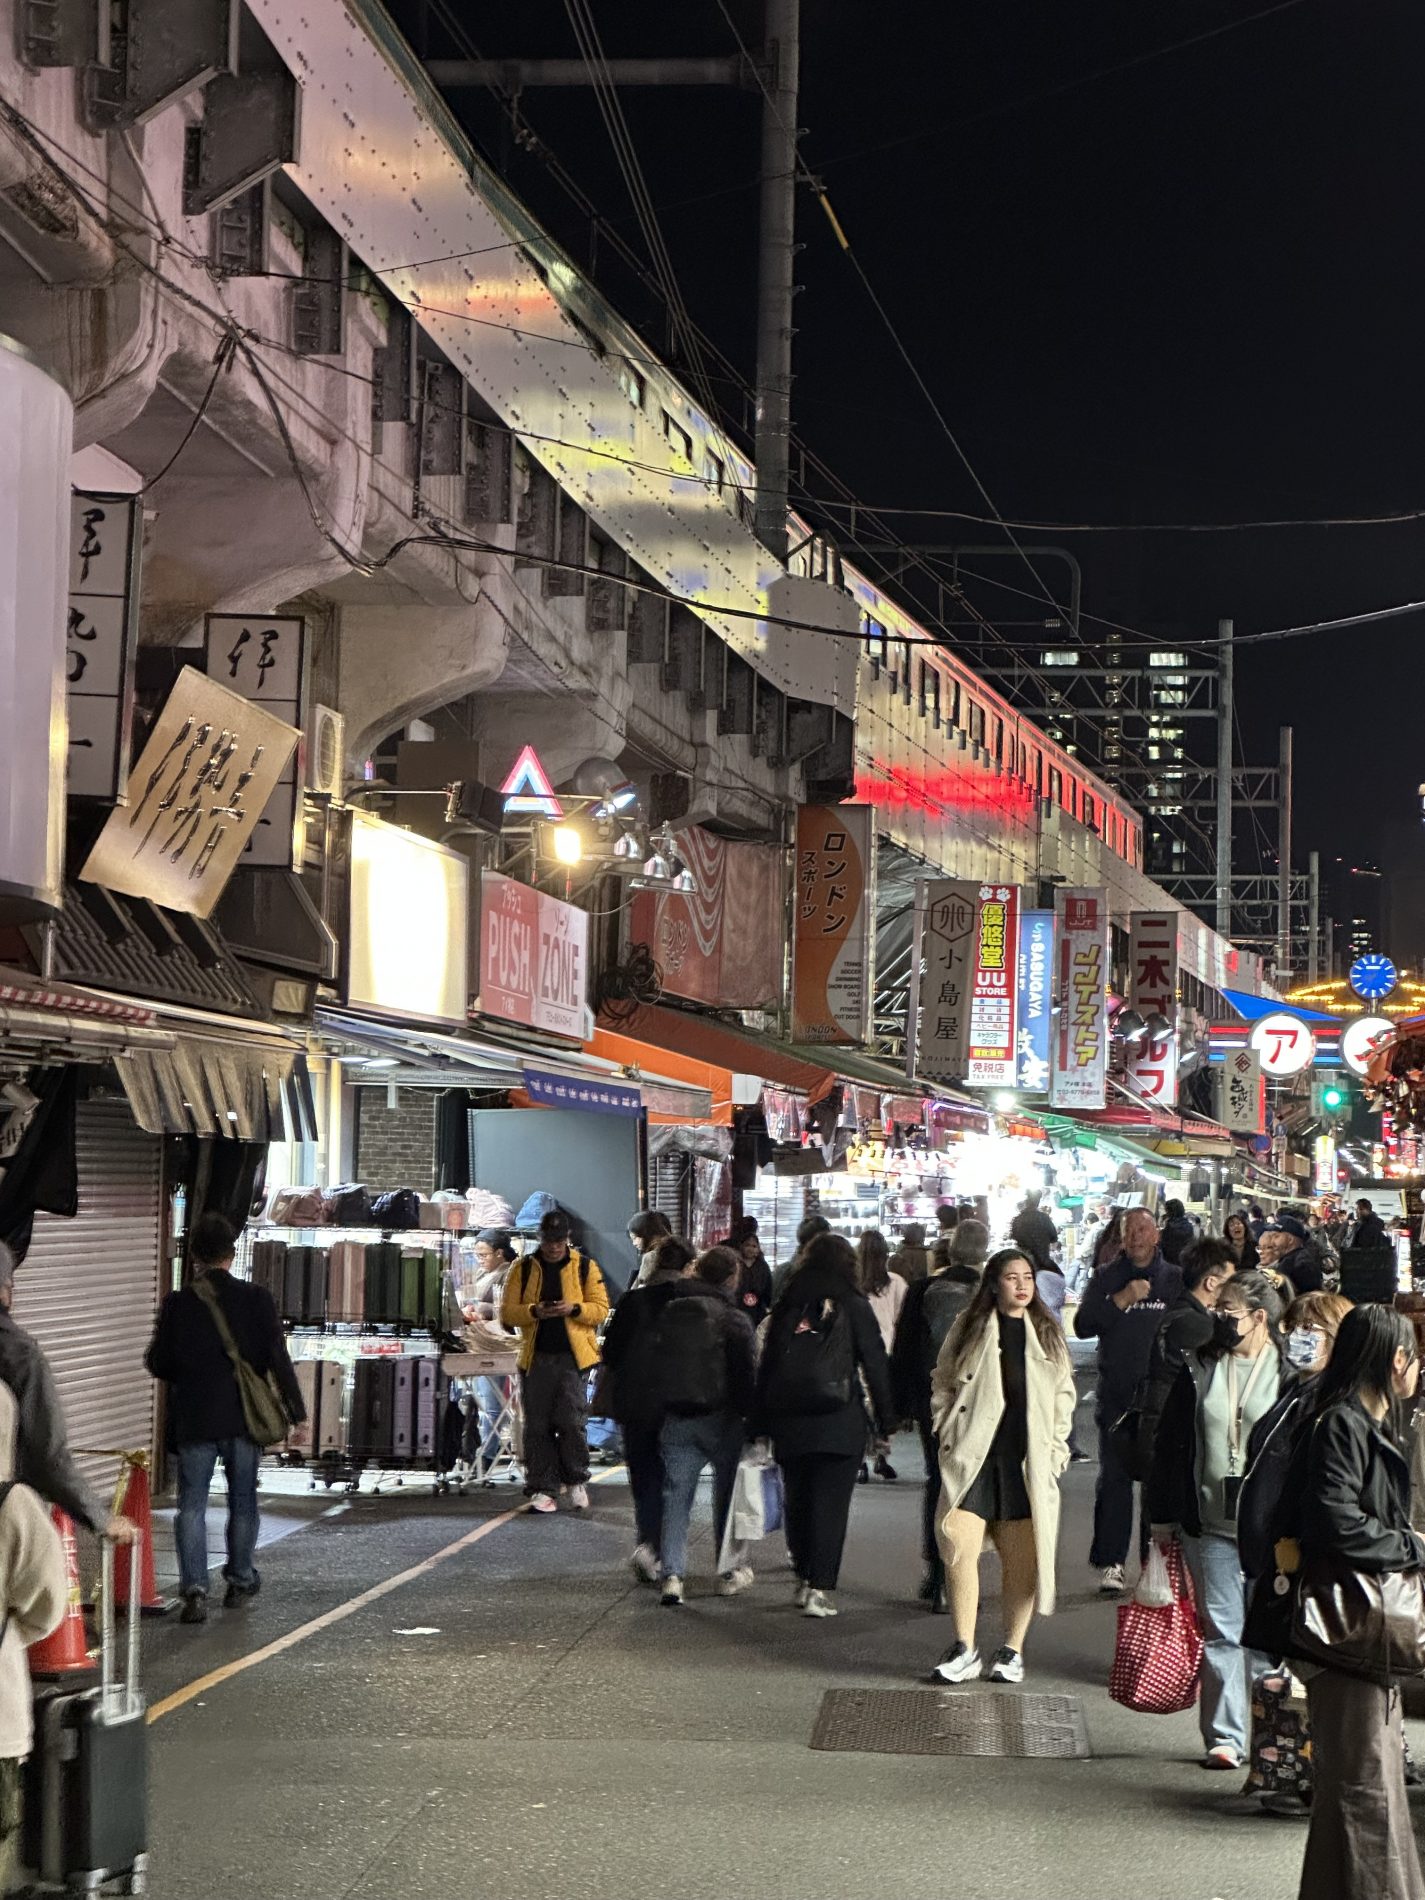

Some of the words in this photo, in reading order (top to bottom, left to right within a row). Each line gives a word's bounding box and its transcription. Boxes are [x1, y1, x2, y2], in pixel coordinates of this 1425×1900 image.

[801, 851, 818, 919] スポーツ
[823, 833, 847, 933] ロンドン
[488, 910, 531, 993] PUSH
[541, 933, 580, 1007] ZONE
[975, 987, 1008, 996] STORE
[977, 972, 1006, 986] UU
[934, 948, 963, 1040] 小島屋
[1072, 944, 1101, 1067] JJTストア
[972, 1062, 1005, 1073] 免税店
[1265, 1030, 1298, 1064] ア
